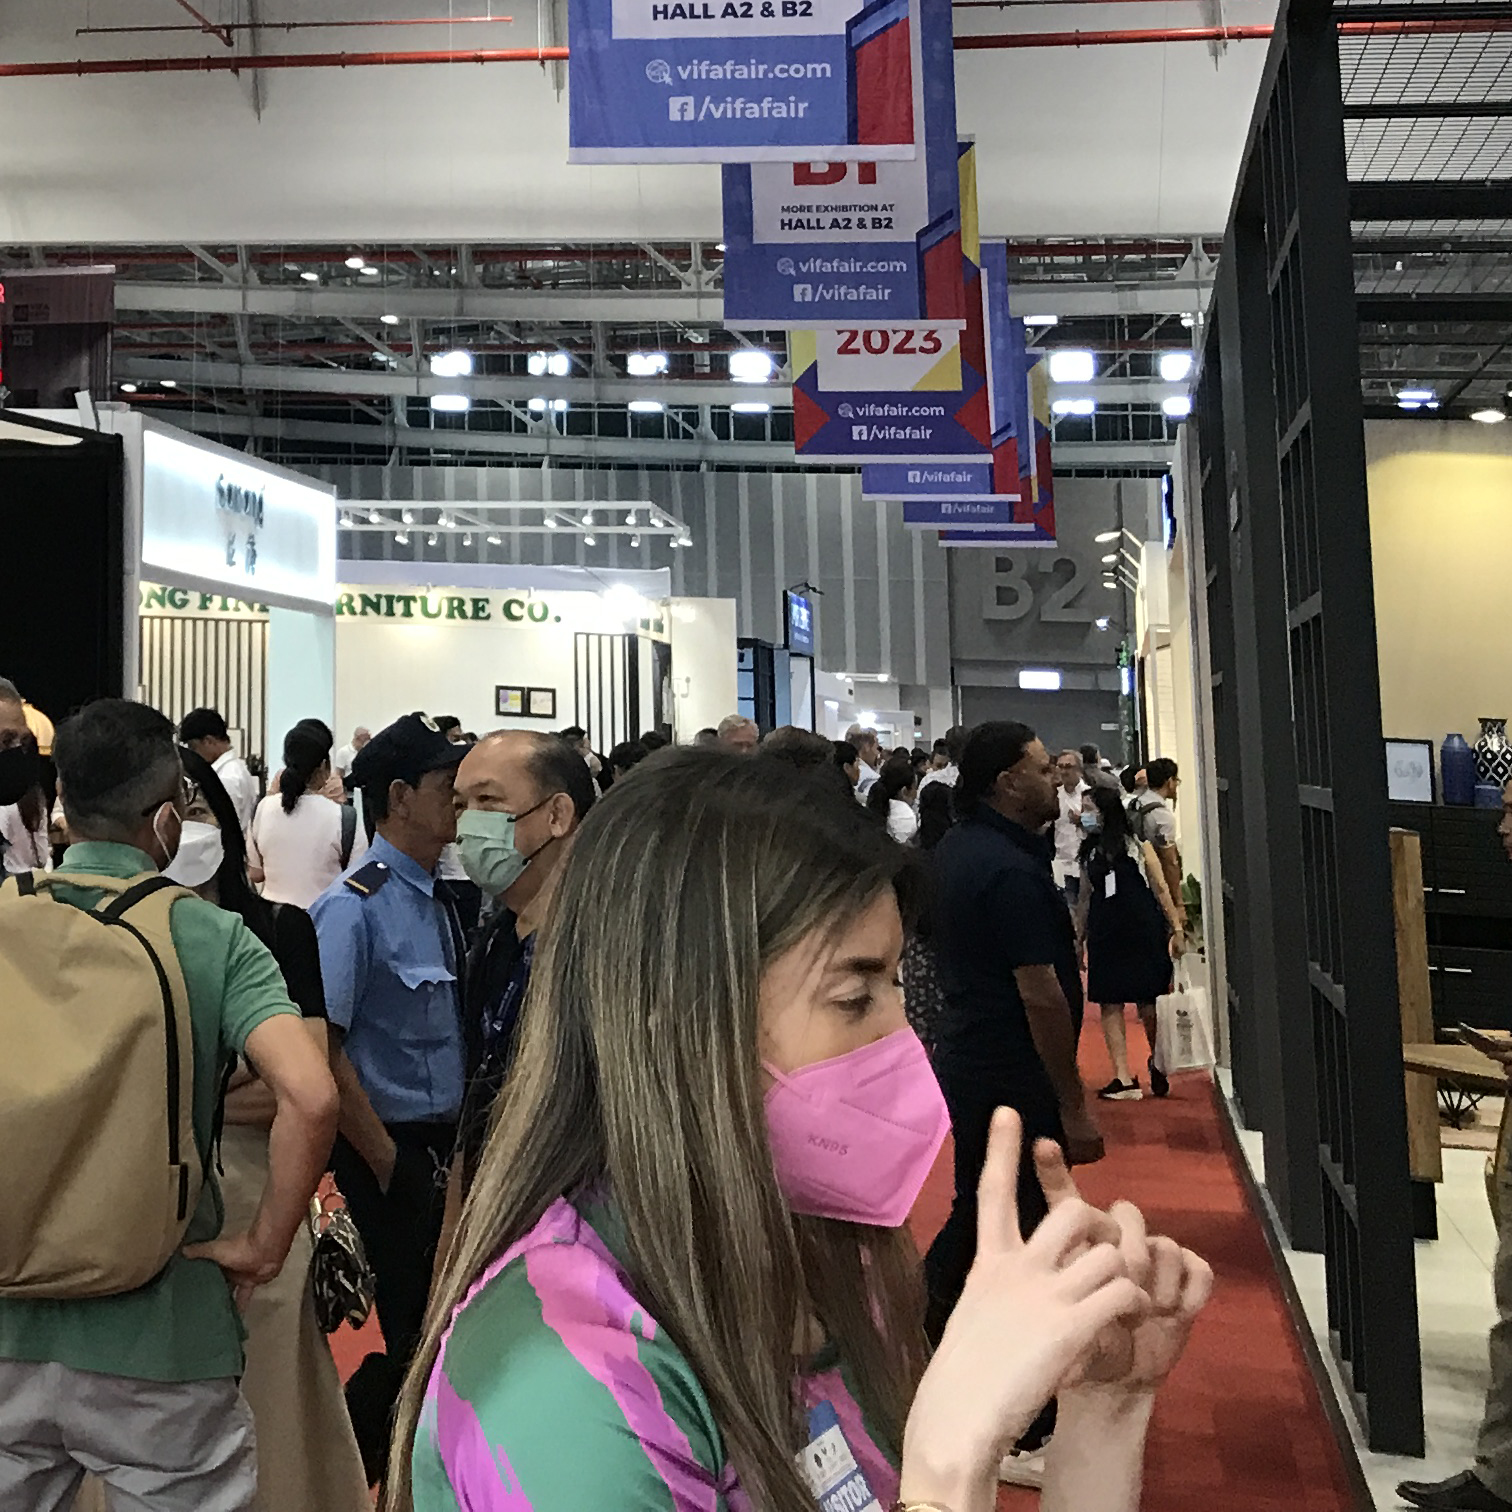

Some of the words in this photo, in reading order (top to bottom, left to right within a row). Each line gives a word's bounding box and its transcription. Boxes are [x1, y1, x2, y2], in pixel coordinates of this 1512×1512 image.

[651, 2, 716, 21] HALL
[720, 1, 753, 19] A2
[759, 1, 778, 18] &
[781, 0, 814, 18] B2
[676, 57, 832, 81] vifafair.com
[780, 204, 813, 214] MORE
[815, 203, 879, 214] EXHIBITION
[880, 203, 895, 212] AT
[780, 218, 826, 230] HALL
[828, 218, 853, 230] A2
[856, 218, 867, 230] &
[871, 217, 894, 230] B2
[798, 257, 908, 273] vifafair.com
[835, 329, 943, 355] 2023
[855, 403, 945, 416] vifafair.com
[139, 586, 190, 610] NG
[982, 550, 1092, 622] B2
[336, 592, 492, 620] RNITURE
[502, 598, 563, 623] CO.
[807, 1133, 851, 1157] KN95
